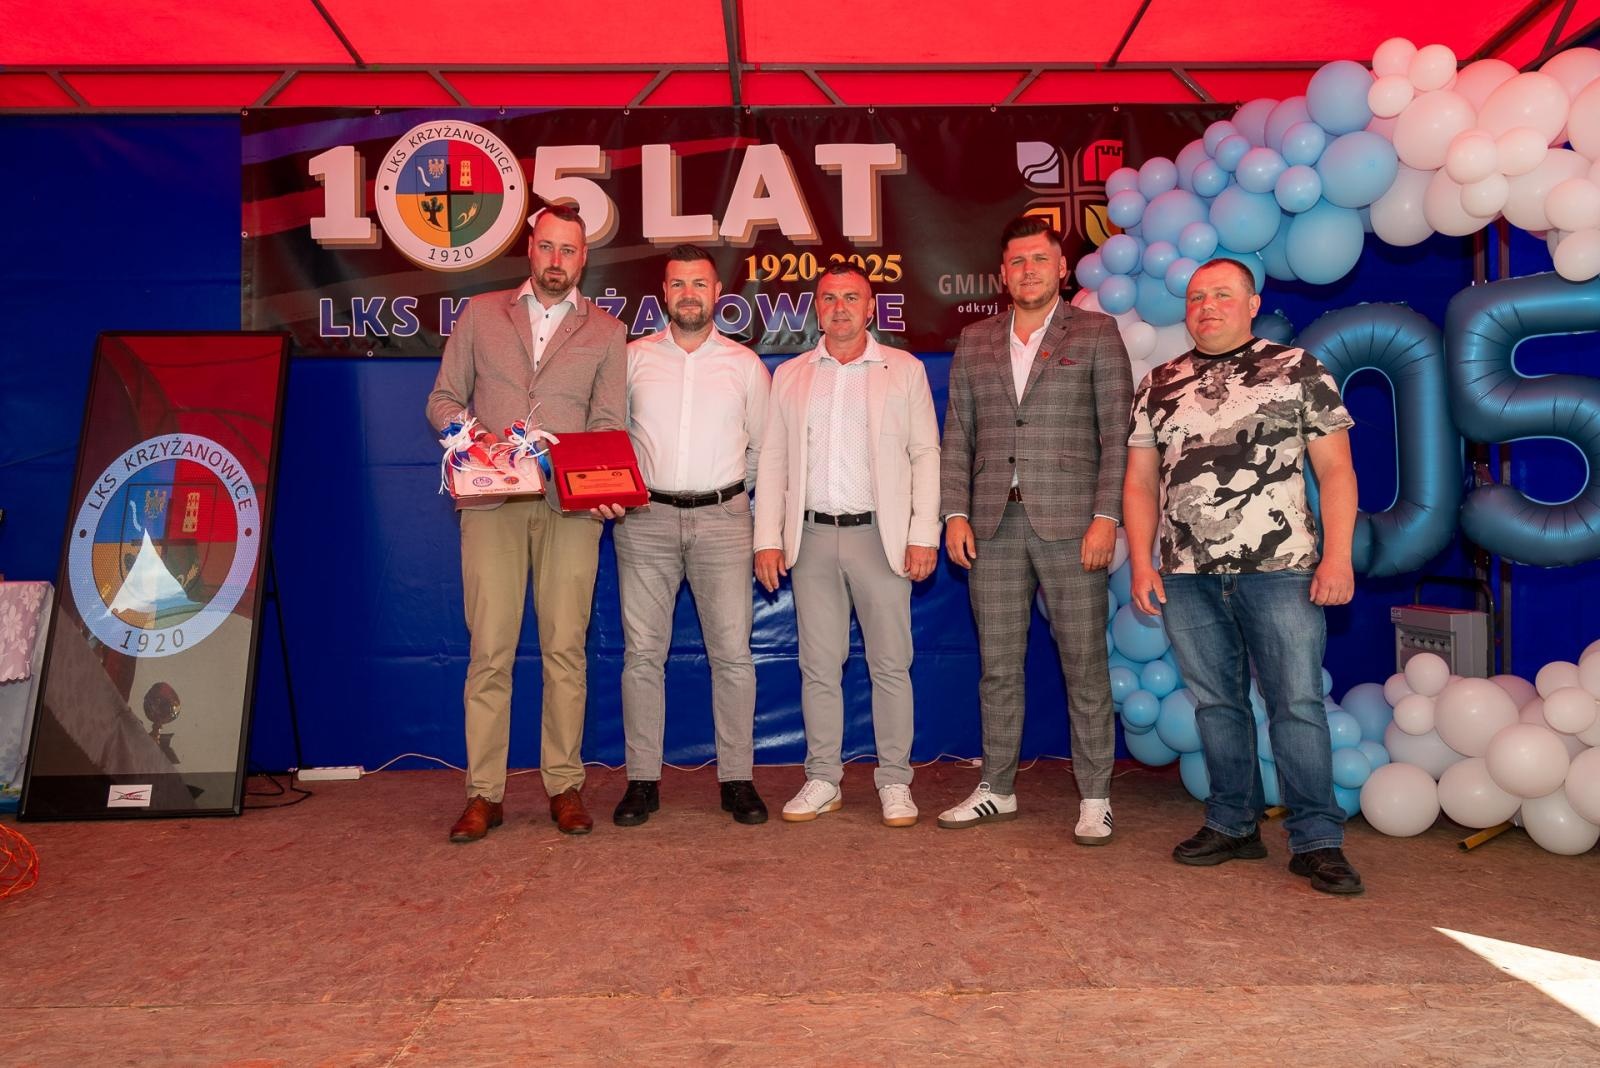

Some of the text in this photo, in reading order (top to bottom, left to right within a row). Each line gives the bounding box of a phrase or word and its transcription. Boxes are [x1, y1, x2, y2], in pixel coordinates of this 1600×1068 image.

[387, 125, 513, 175] LKS KRZYŻANOWICE
[641, 142, 904, 245] LAT
[428, 246, 474, 262] 1920
[938, 274, 1005, 295] GMIN
[319, 296, 420, 337] LKS
[958, 302, 998, 315] odkryj
[88, 437, 253, 512] LKS KRZYŻANOWICE
[120, 628, 185, 653] 1920
